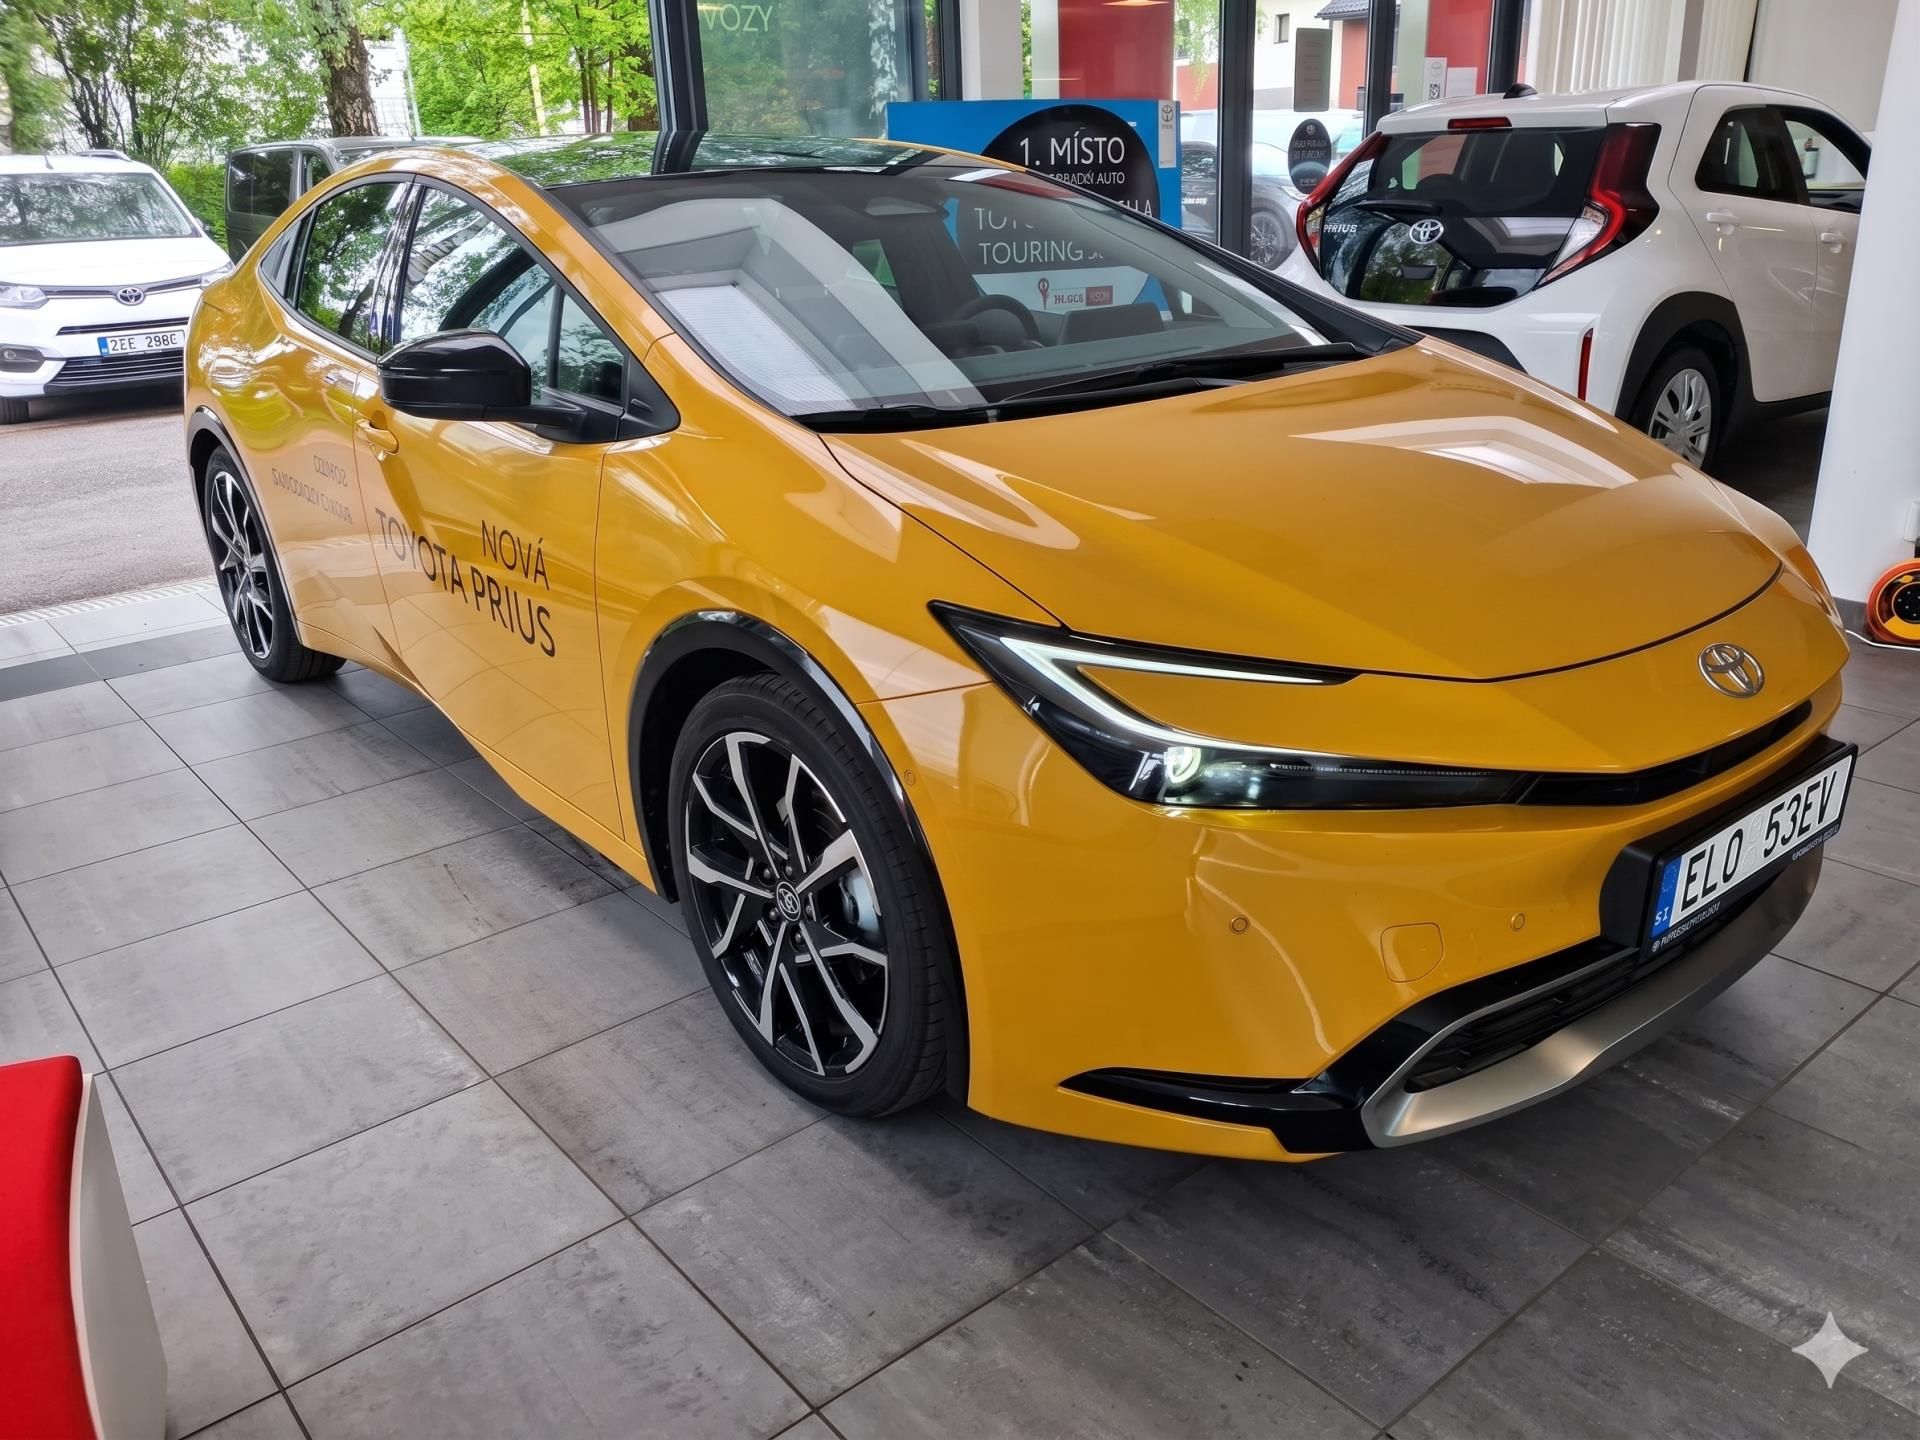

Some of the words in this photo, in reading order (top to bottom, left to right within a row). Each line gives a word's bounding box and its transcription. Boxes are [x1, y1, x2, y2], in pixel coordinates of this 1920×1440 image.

[703, 4, 773, 32] VOZY
[1019, 138, 1041, 166] 1.
[1050, 131, 1125, 165] MÍSTO
[1097, 172, 1125, 185] AUTO
[978, 240, 1083, 265] TOURING
[110, 337, 137, 352] 2EE
[481, 519, 550, 591] NOVÁ
[375, 506, 468, 604] TOYOTA
[470, 565, 556, 658] PRIUS
[1763, 770, 1838, 859] 53EV
[1654, 906, 1669, 926] SI
